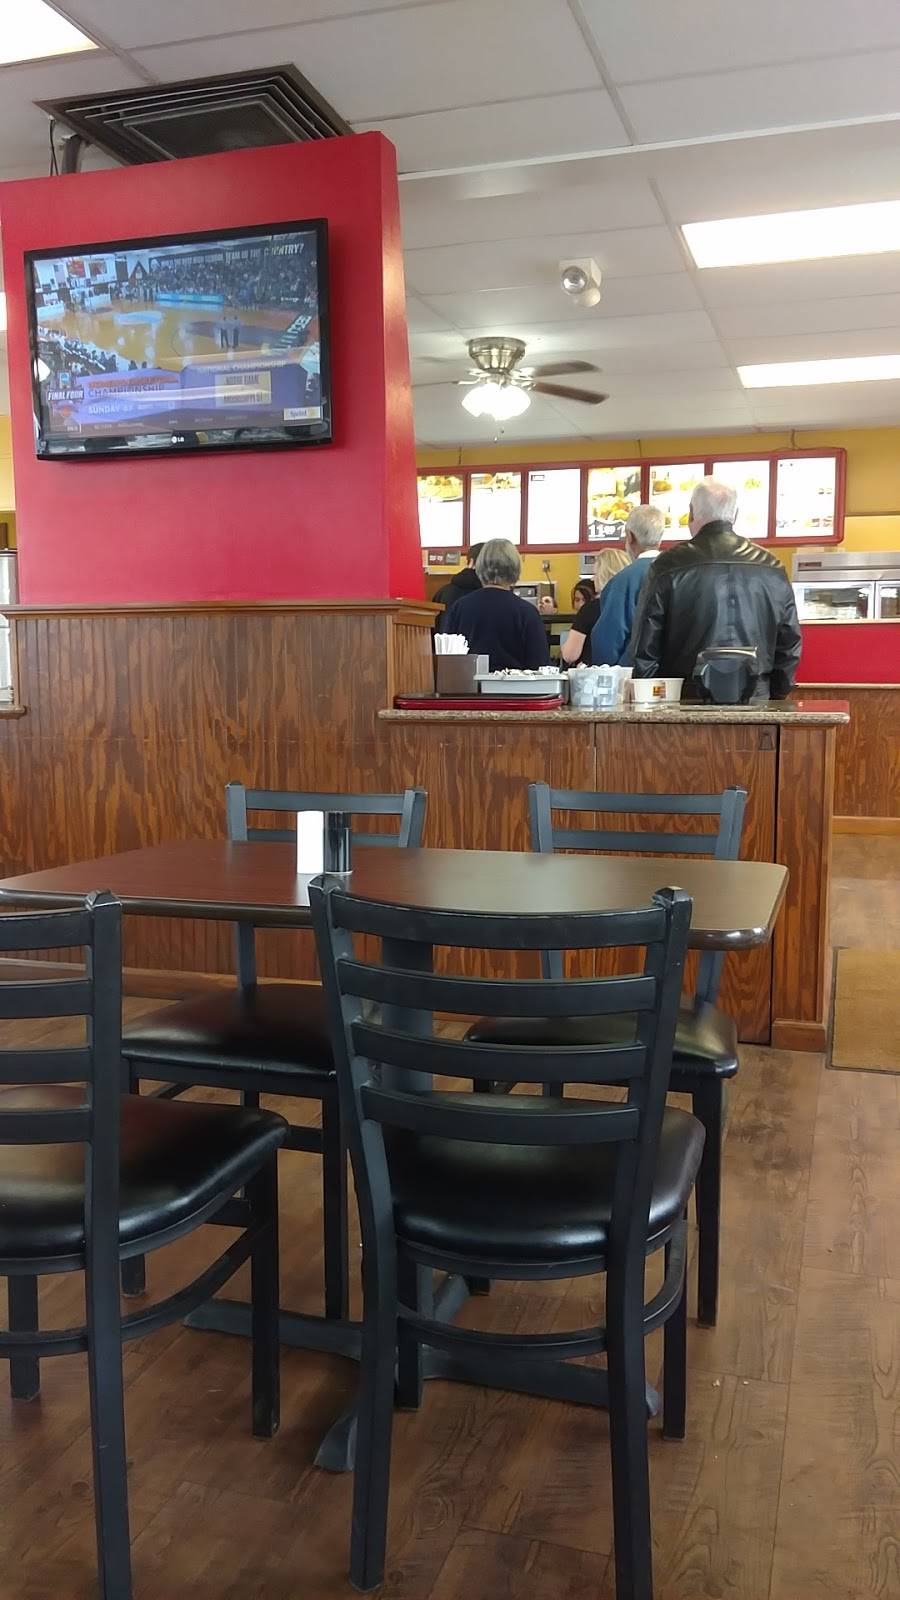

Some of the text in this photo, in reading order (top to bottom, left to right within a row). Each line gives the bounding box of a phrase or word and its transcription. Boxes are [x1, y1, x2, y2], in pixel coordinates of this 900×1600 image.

[48, 389, 84, 400] FINAL FOUR
[88, 403, 120, 414] SUNDAY
